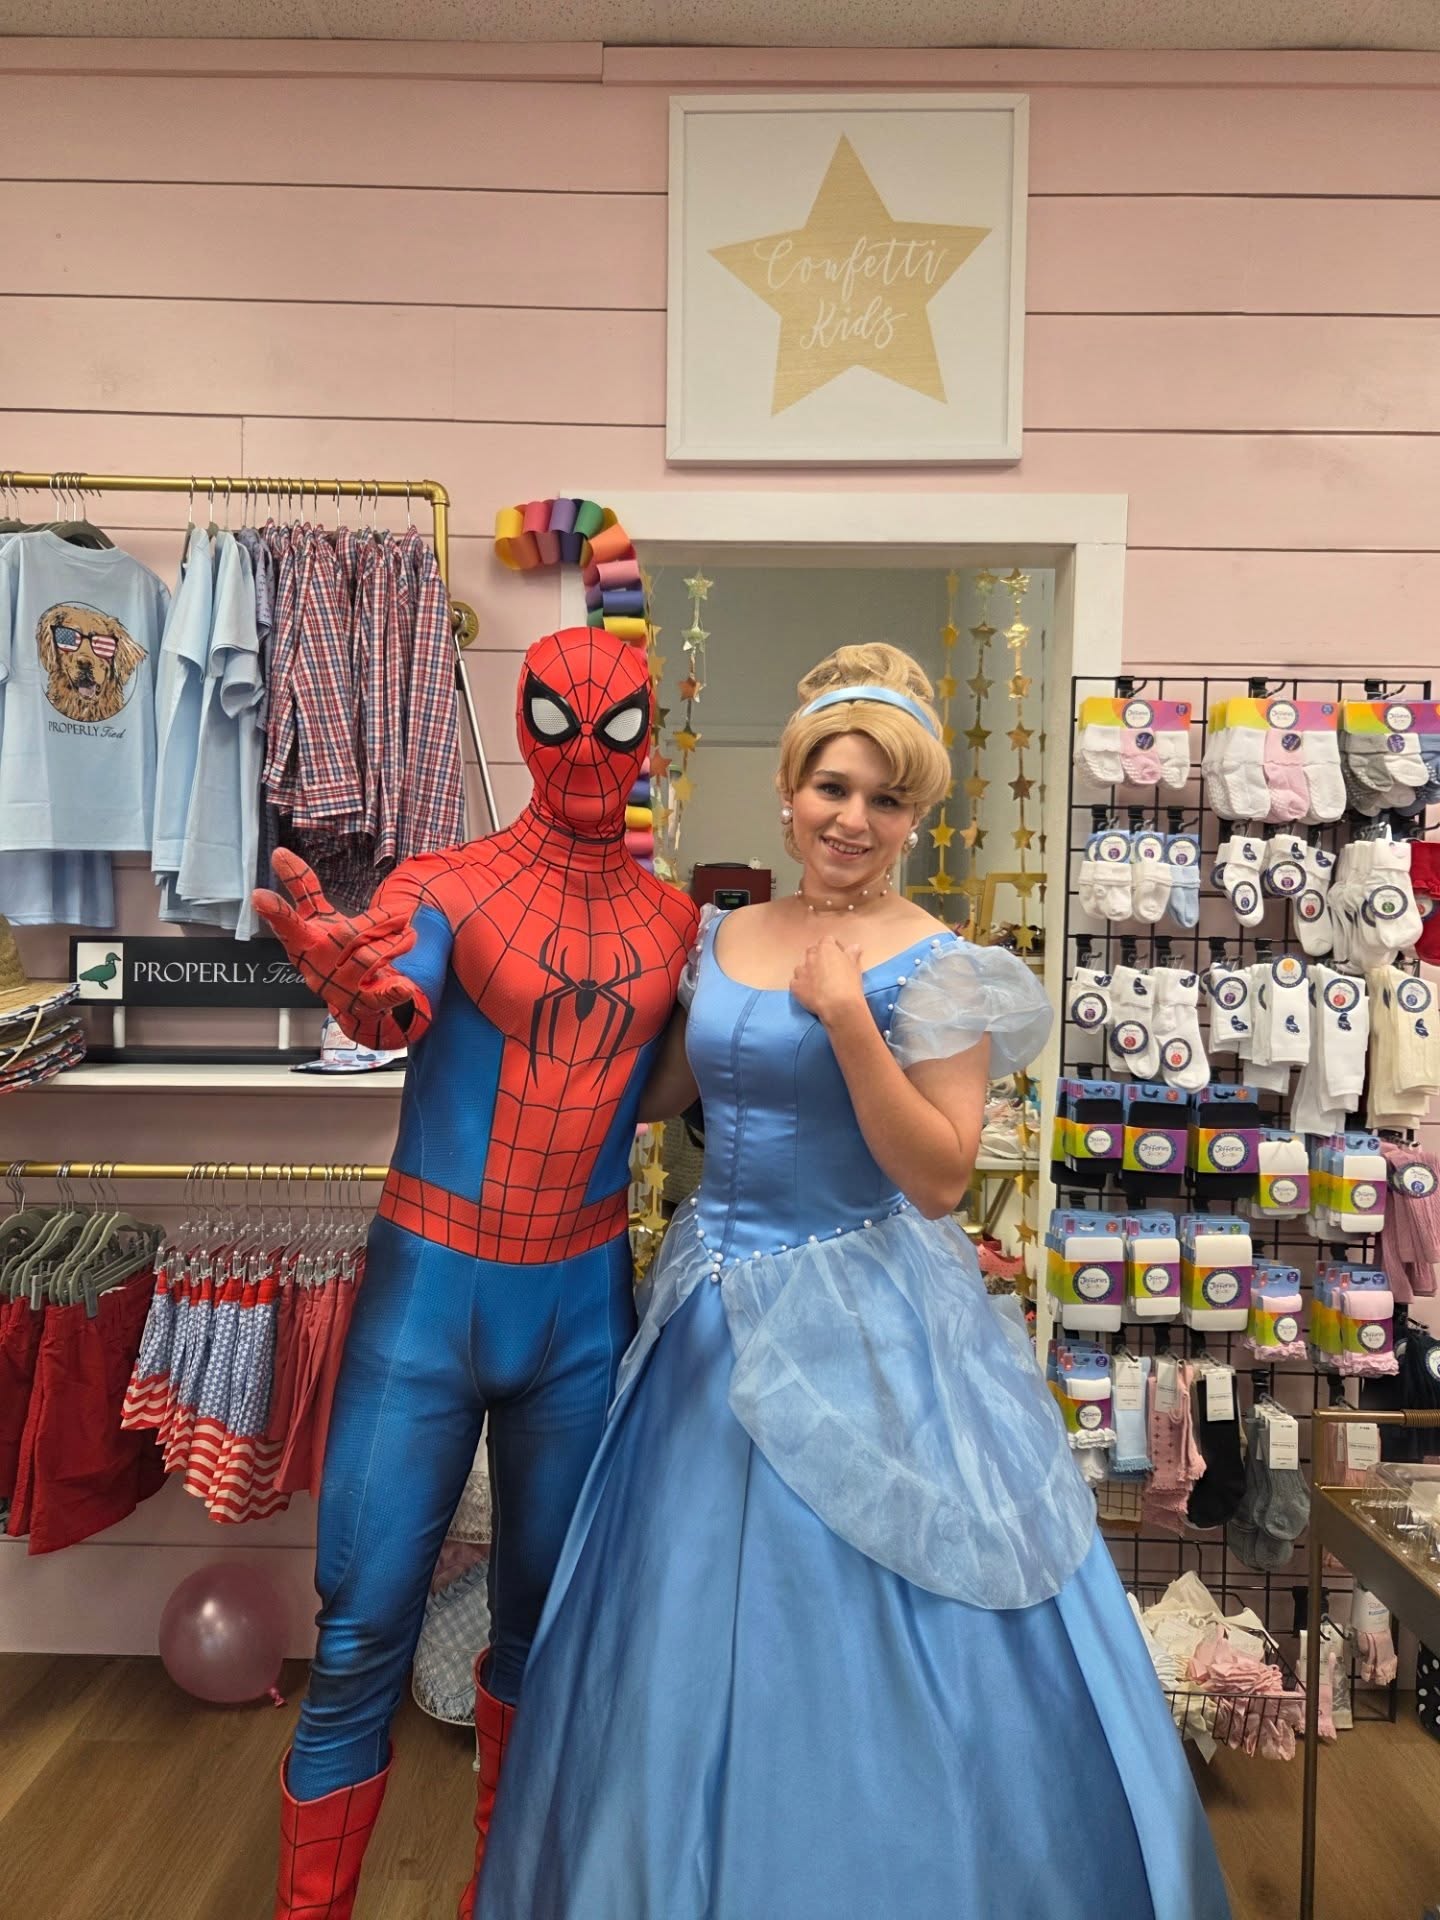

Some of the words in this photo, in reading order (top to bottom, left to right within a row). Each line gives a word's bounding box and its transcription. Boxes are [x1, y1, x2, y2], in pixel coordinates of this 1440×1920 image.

[753, 235, 949, 301] Confetti
[799, 295, 908, 349] Kids
[48, 720, 99, 737] PROPERLY
[100, 726, 126, 739] Tied
[133, 961, 260, 983] PROPERLY
